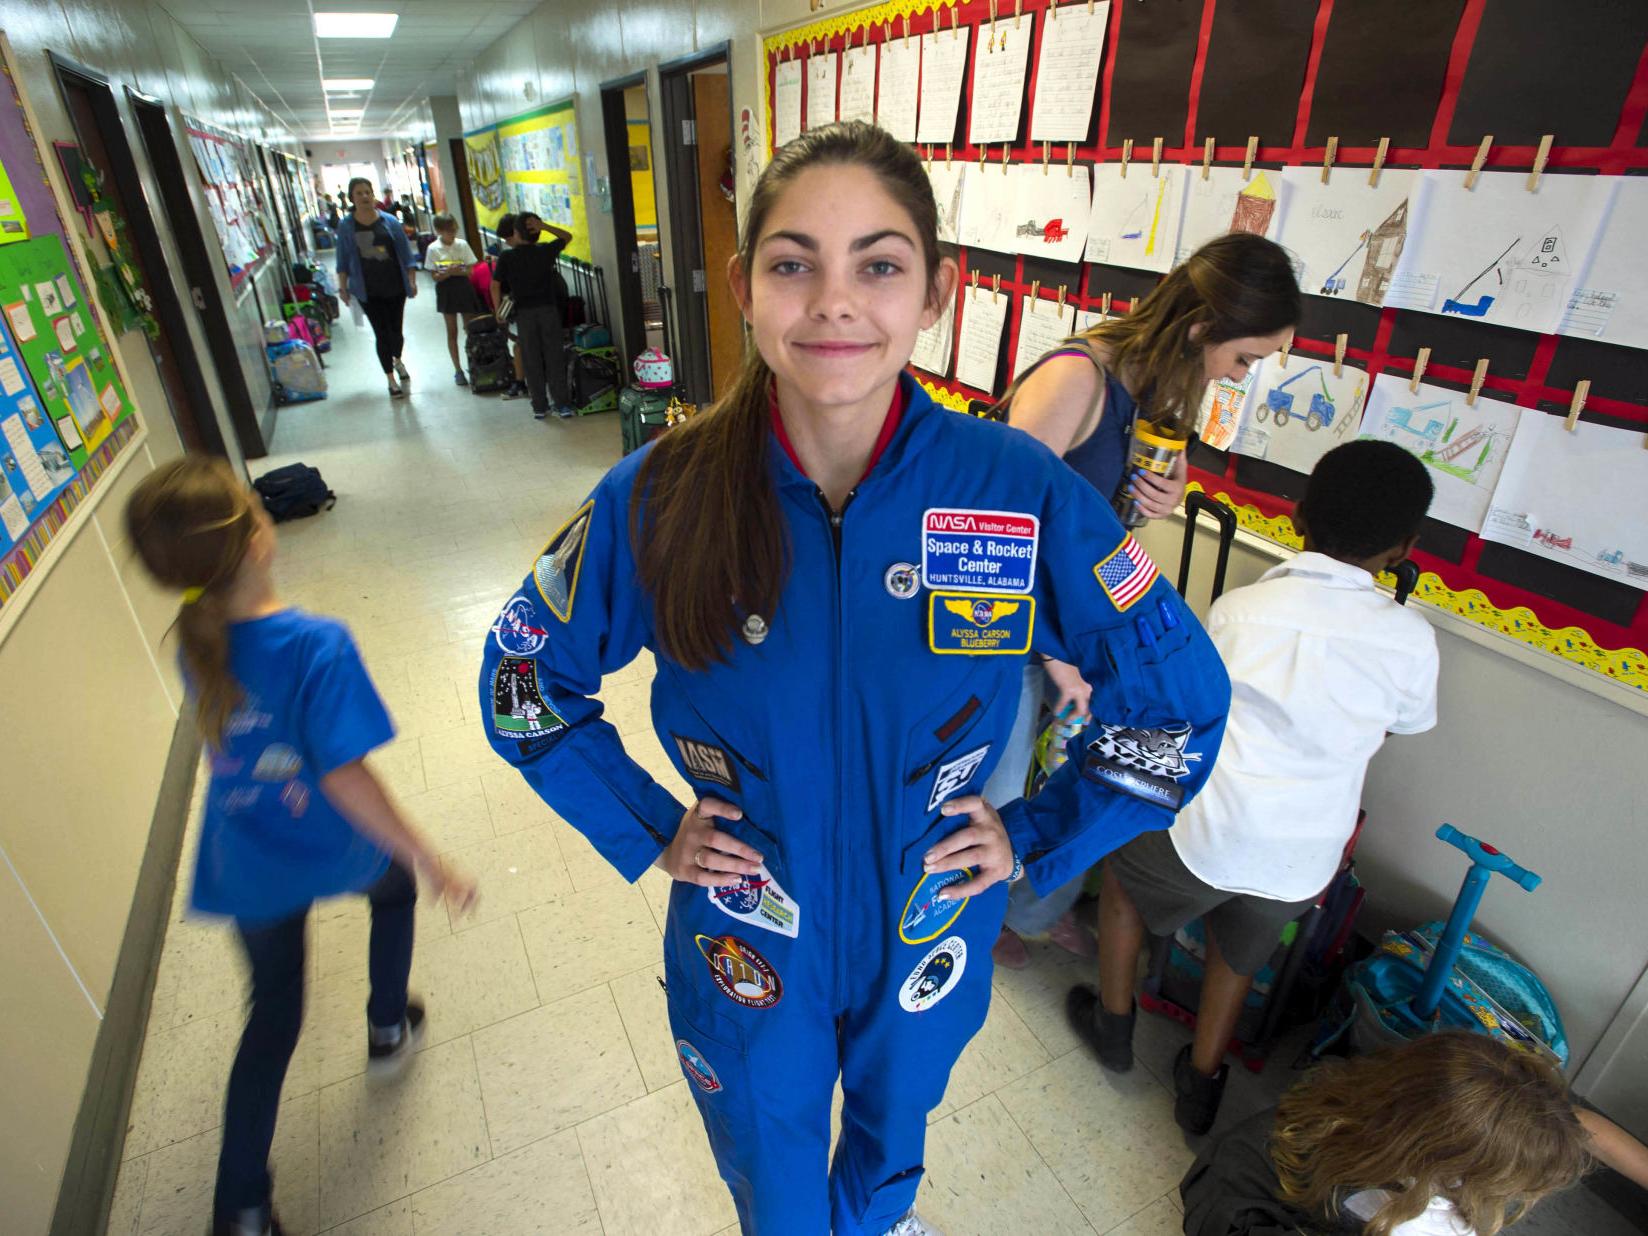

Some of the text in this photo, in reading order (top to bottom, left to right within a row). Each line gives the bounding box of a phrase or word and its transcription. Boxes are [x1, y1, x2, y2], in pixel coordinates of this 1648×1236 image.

[929, 514, 1031, 534] NASA Visitor Center
[928, 538, 1032, 559] Space & Rocket
[958, 557, 1002, 574] Center
[930, 574, 1025, 587] HUNTSVILLE, ALABAMA
[951, 628, 1011, 639] ALYSSA CARSON
[961, 638, 1000, 648] BLUEBERRY
[526, 724, 563, 738] CARSON
[930, 872, 964, 895] NATIONAL
[760, 909, 784, 928] CENTER
